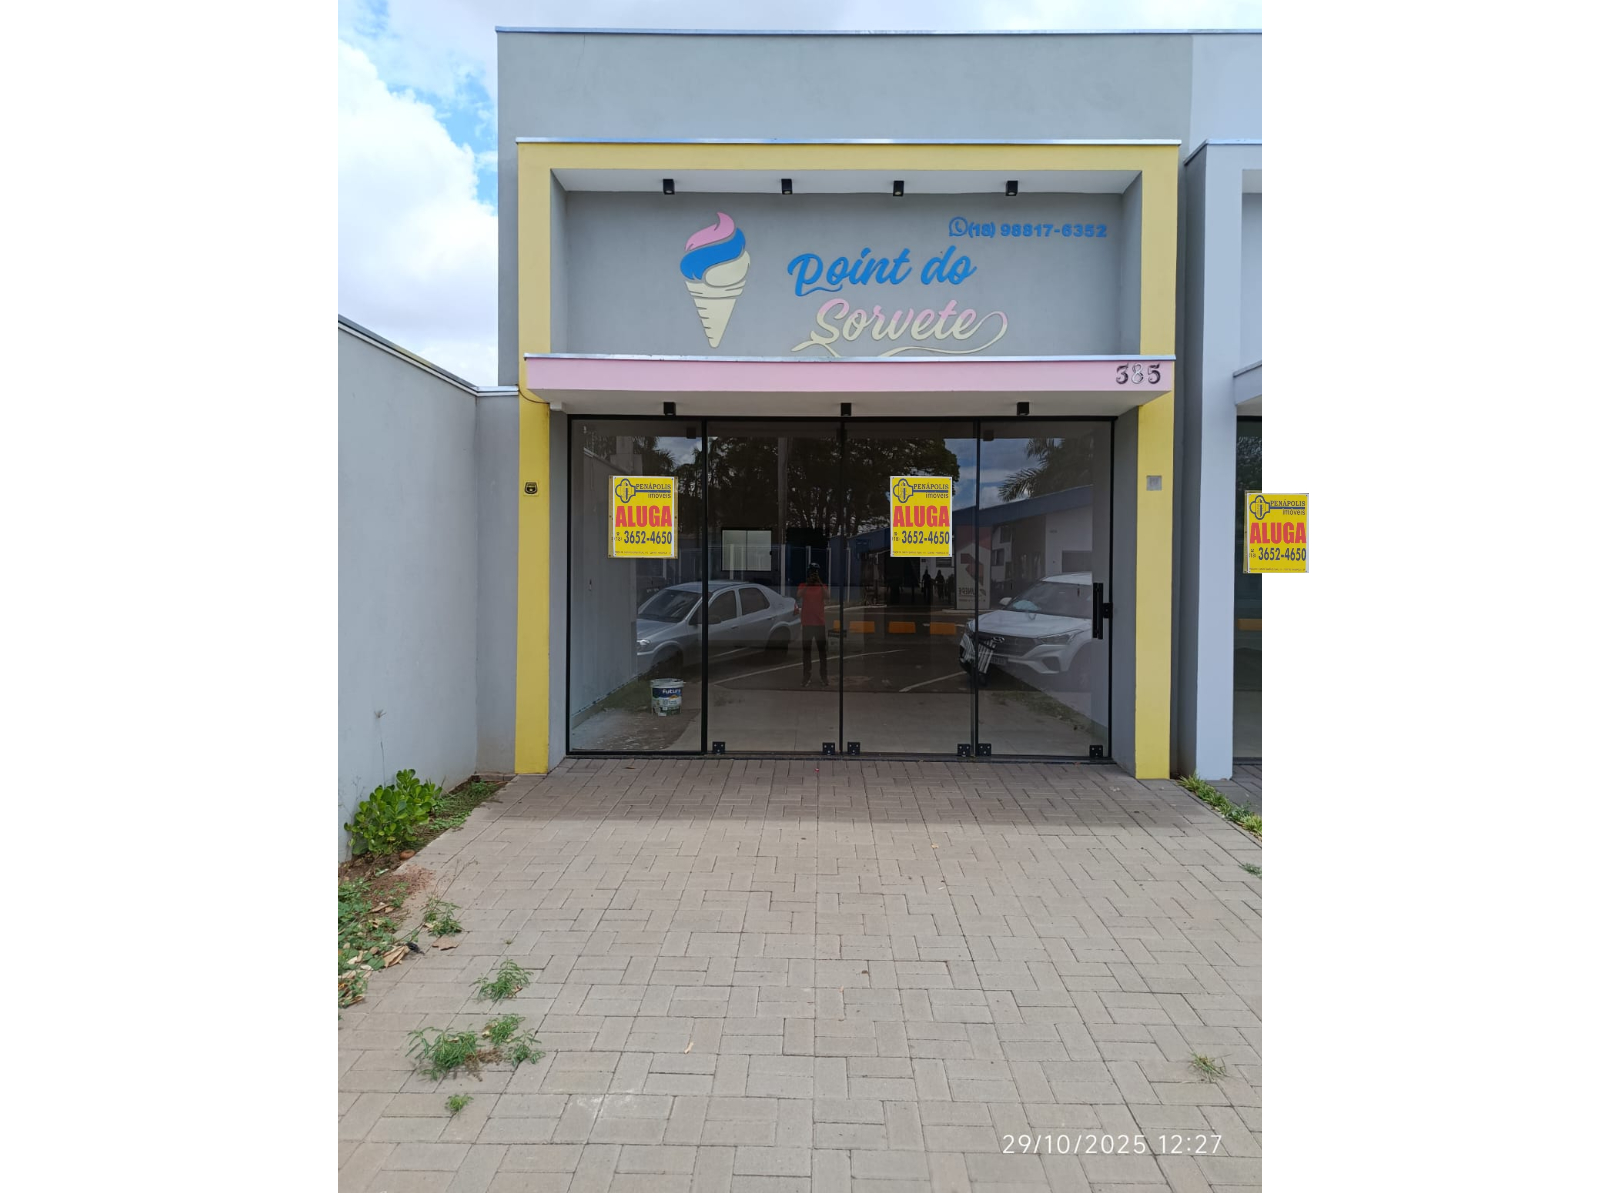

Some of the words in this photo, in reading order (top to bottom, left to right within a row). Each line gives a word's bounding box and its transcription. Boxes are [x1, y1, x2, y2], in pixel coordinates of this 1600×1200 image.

[968, 222, 996, 239] (18)
[1000, 223, 1108, 238] 98817-6352
[787, 247, 912, 297] Point
[920, 245, 977, 285] do
[800, 298, 1008, 350] Sorvete
[1115, 362, 1161, 385] 385
